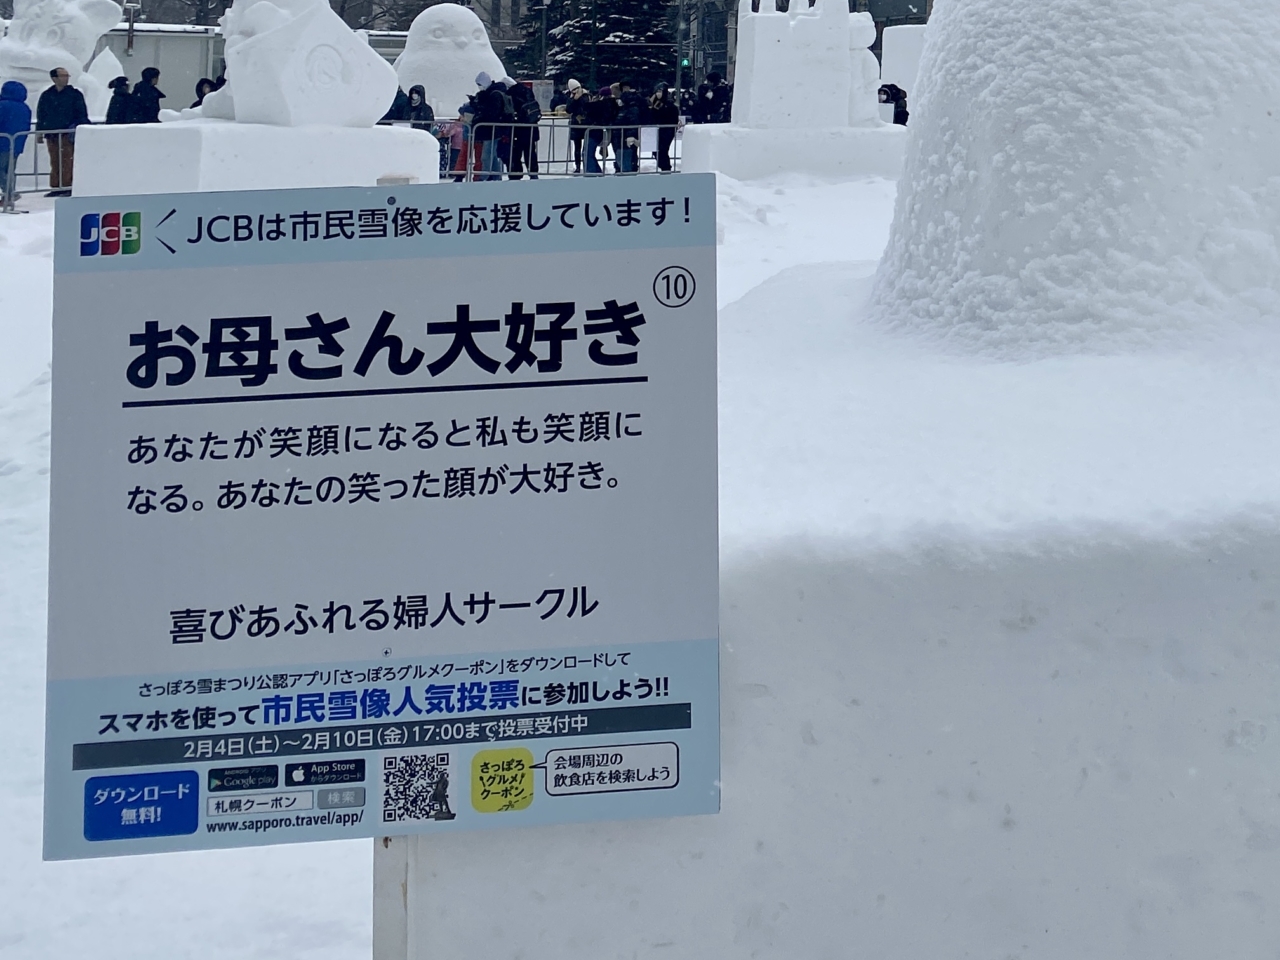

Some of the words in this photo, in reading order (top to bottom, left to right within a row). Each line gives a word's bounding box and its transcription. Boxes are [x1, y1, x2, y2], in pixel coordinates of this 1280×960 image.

[187, 197, 693, 244] JCBは市民雪像を応援しています!
[126, 298, 647, 389] お母さん大好き
[128, 410, 642, 464] あなたが笑顔になると私も笑顔に
[127, 461, 620, 515] なる。あなたの笑った顔が大好き。
[169, 586, 599, 644] 喜びあふれる婦人サークル
[138, 652, 630, 698] さっぽろ雪まつり公認アプリ「さっぽろグルメクーポン」をダウンロードして
[98, 676, 669, 735] スマホを使って市民雪像人気投票に参加しよう!!
[311, 763, 329, 774] App
[331, 762, 355, 771] Store
[480, 759, 525, 772] さっぽろ
[553, 754, 623, 770] 会場周辺の
[224, 775, 257, 789] Google
[258, 775, 276, 787] play
[311, 772, 362, 783] からダウンロード
[486, 773, 518, 786] グルメ
[554, 766, 670, 788] 飲食店を検索しよう
[92, 782, 190, 806] ダウンロード
[327, 791, 355, 804] 検索
[481, 786, 525, 800] クーポン
[215, 796, 296, 813] 札幌クーポン
[121, 805, 162, 826] 無料!
[207, 810, 363, 833] www.sapporo.travel/app/
